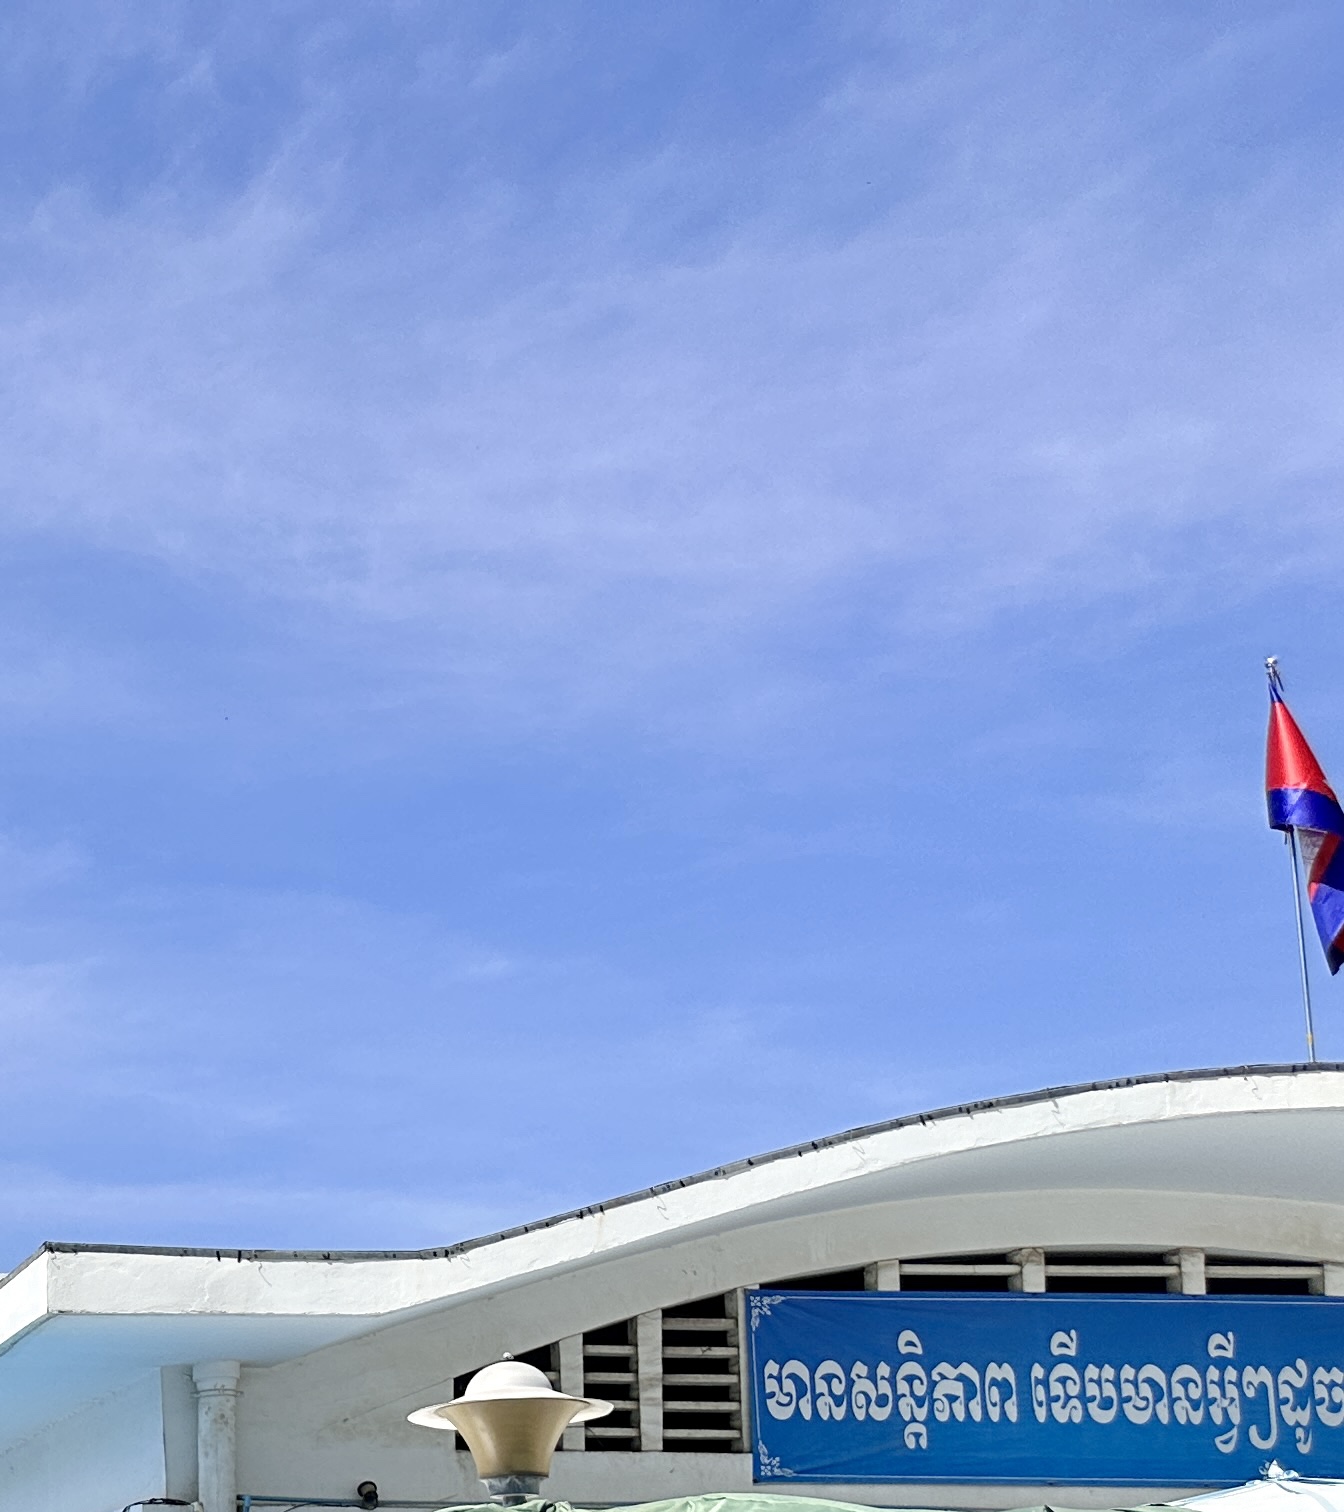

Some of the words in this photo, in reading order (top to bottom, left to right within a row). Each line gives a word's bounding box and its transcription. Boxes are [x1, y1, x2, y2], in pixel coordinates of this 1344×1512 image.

[763, 1329, 1018, 1451] មានសន្តិភាព
